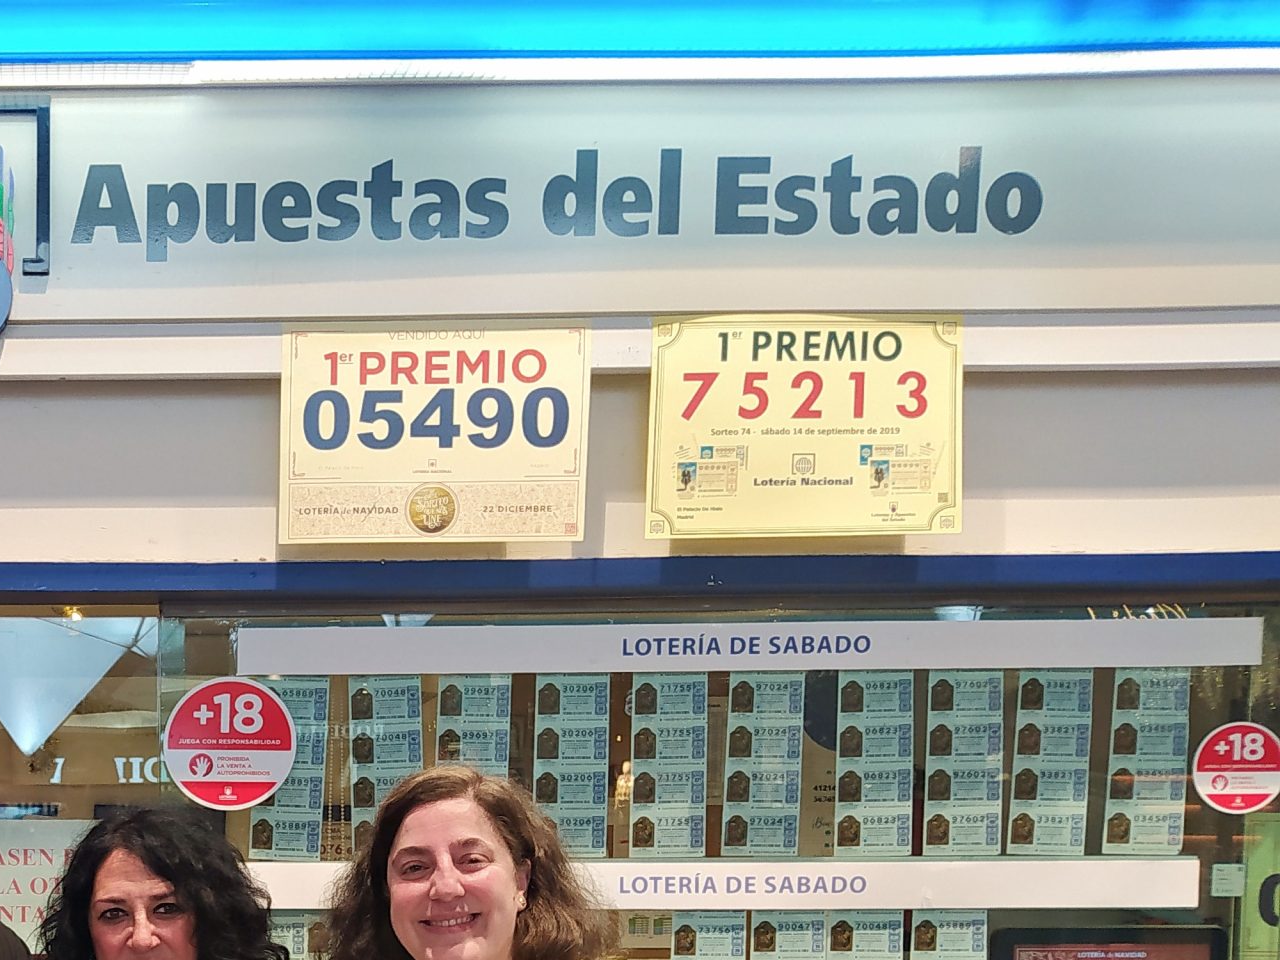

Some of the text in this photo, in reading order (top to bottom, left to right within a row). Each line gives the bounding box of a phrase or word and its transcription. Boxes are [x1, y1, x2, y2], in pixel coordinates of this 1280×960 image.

[71, 159, 510, 263] Apuestas
[543, 148, 683, 238] del
[714, 145, 1044, 236] Estado
[388, 329, 448, 341] VENDIDO
[752, 331, 902, 362] PREMIO
[324, 349, 547, 385] 1er PREMIO
[303, 387, 570, 450] 05490
[711, 427, 900, 437] Sorteo 74 sábado 14 de septiembre de 2019
[753, 476, 853, 486] Lotería Nacional
[299, 505, 340, 515] LOTERÍA
[353, 506, 399, 515] NAVIDAD
[482, 505, 553, 513] 22 DICIEMBRE
[622, 633, 871, 656] LOTERÍA DE SABADO
[562, 683, 595, 692] 30206
[865, 681, 898, 689] 06823
[193, 693, 264, 734] +18
[561, 728, 594, 737] 30206
[865, 726, 898, 735] 06823
[1214, 732, 1266, 761] +18
[560, 773, 593, 781] 30206
[864, 772, 897, 780] 06823
[558, 817, 592, 826] 30206
[862, 816, 896, 825] 06823
[619, 873, 867, 894] LOTERÍA DE SABADO
[698, 925, 731, 934] 73756
[778, 923, 810, 931] 90047
